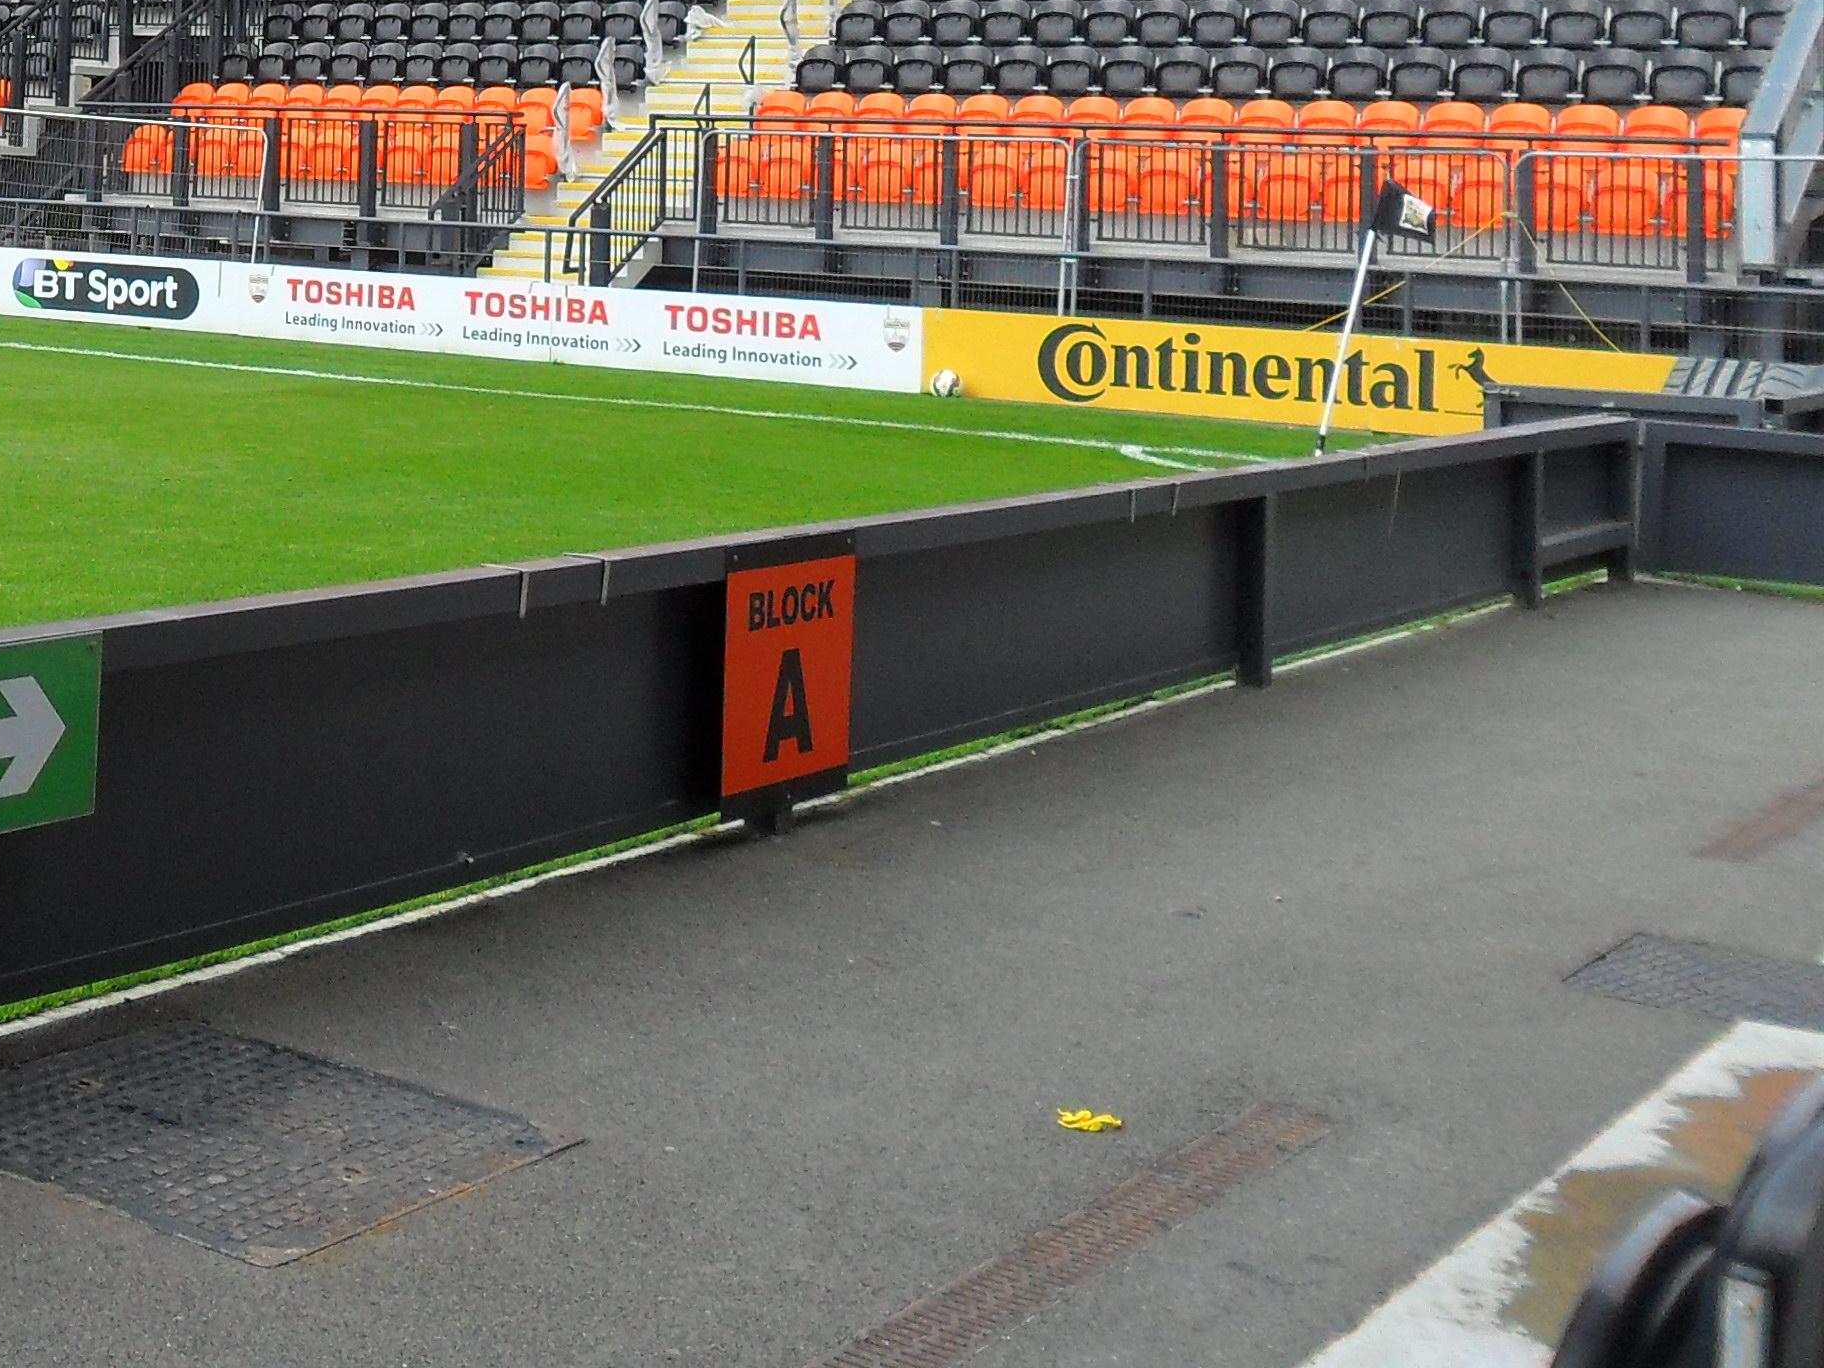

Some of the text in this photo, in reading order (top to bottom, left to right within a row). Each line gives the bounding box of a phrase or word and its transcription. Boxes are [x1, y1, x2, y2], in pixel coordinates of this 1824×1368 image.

[33, 269, 178, 311] BT Sport
[287, 278, 416, 311] TOSHIBA
[465, 290, 609, 326] TOSHIBA
[285, 311, 416, 336] Leading Innovation
[463, 326, 609, 351] Leading Innovation
[664, 304, 822, 342] TOSHIBA
[663, 341, 822, 368] Leading Innovation
[1037, 322, 1439, 413] Continental
[748, 578, 835, 632] BLOCK
[762, 648, 813, 763] A
